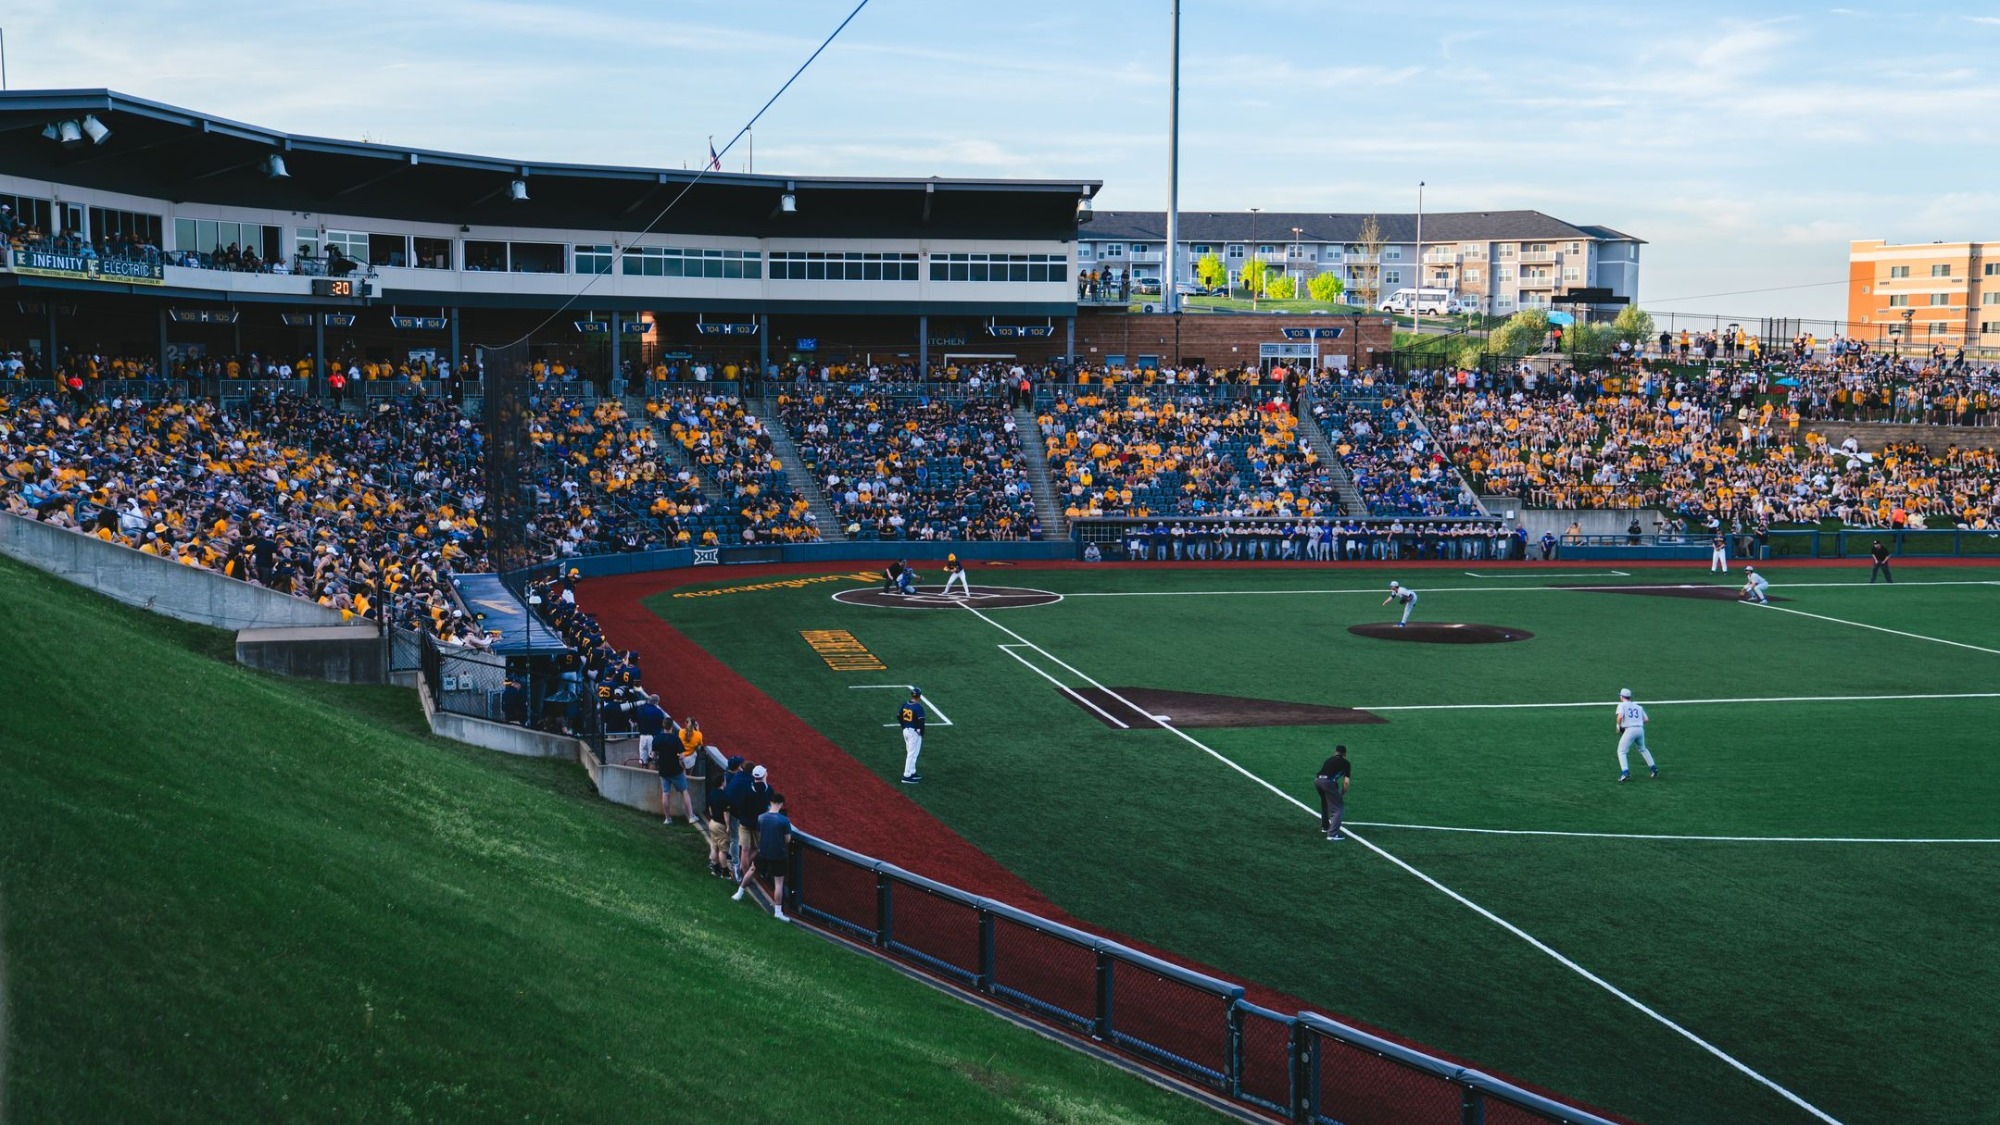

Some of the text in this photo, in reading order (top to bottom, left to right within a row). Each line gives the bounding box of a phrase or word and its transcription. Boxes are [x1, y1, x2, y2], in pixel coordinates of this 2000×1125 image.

[32, 253, 83, 270] INFINITY
[103, 261, 149, 277] ELECTRIC
[333, 317, 347, 325] 105
[399, 319, 439, 328] 105 104
[706, 325, 719, 333] 104
[998, 328, 1044, 336] 103 102
[1290, 329, 1334, 337] 102 101
[928, 338, 965, 346] ITCHEN
[623, 672, 630, 683] 6
[598, 686, 611, 698] 25
[902, 708, 913, 722] 29
[1628, 708, 1639, 718] 33
